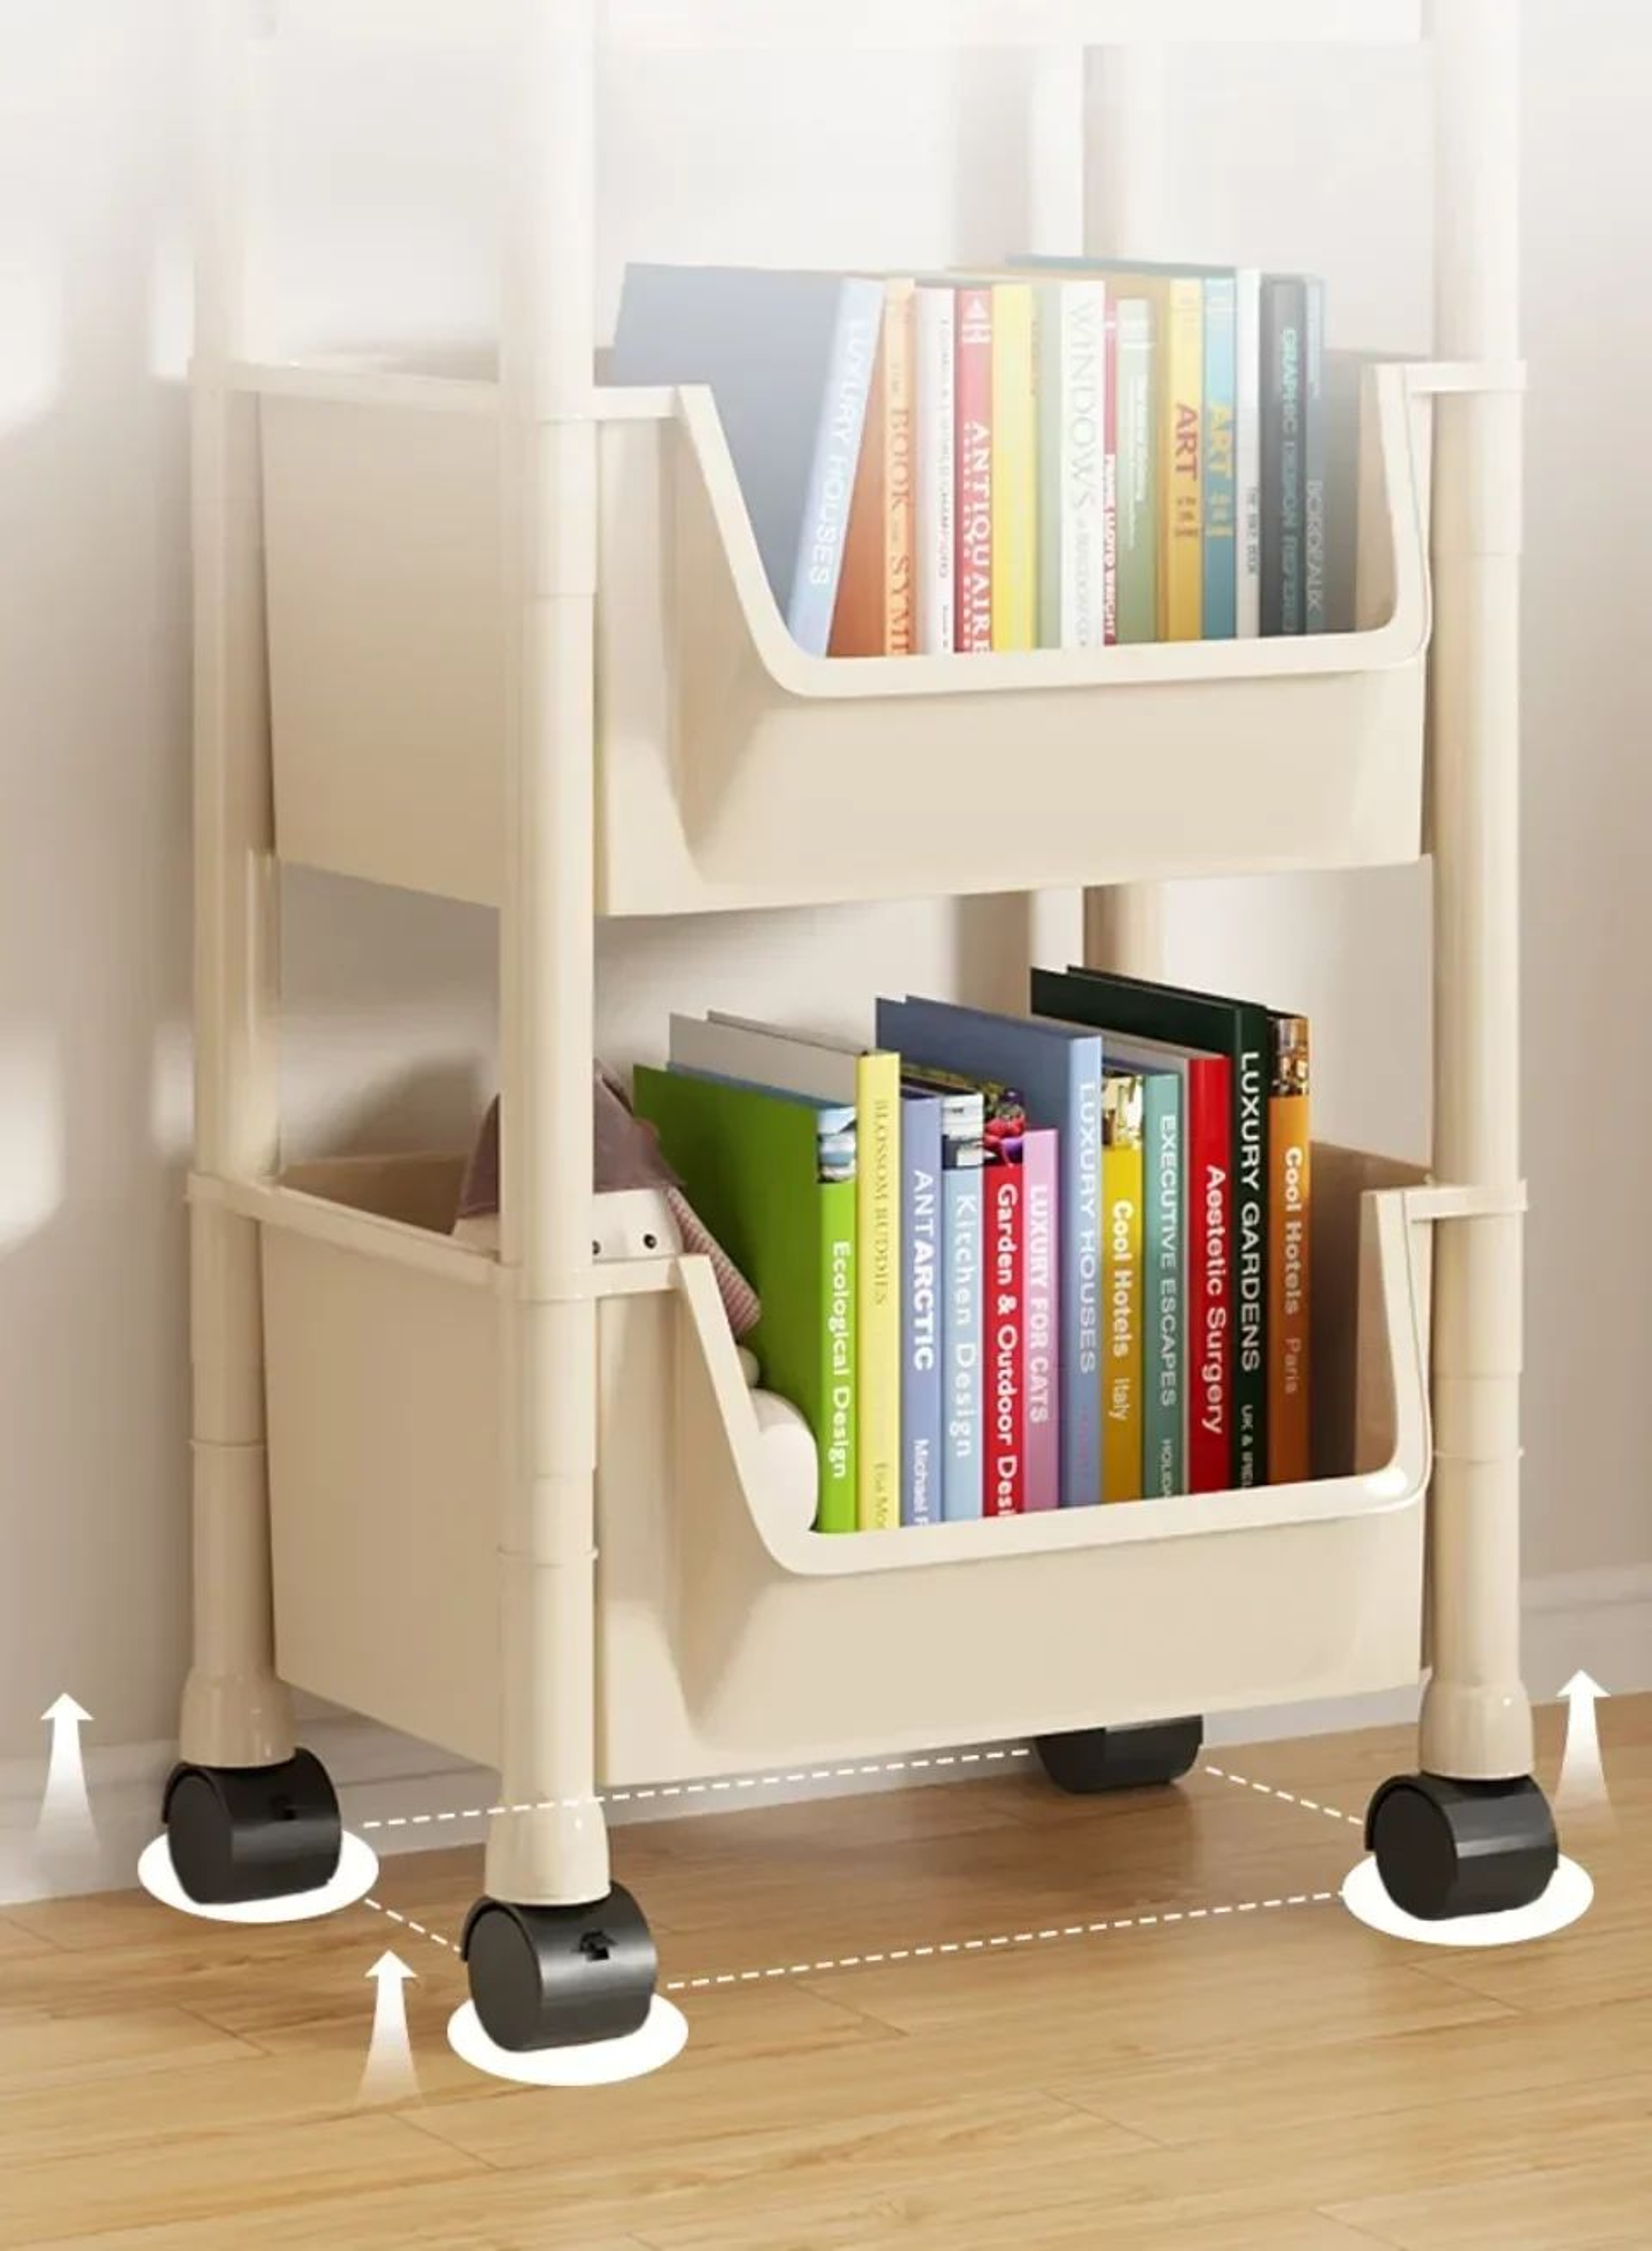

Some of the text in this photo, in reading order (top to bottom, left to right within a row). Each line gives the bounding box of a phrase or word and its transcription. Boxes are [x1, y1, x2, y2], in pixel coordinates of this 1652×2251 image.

[1071, 301, 1097, 510] WINDOWS
[1176, 403, 1199, 481] ART
[1210, 404, 1233, 480] ART
[1281, 328, 1298, 434] GRAPHIC
[809, 318, 869, 586] LUXURY HOUSES
[891, 408, 910, 511] BOOK
[1104, 513, 1116, 566] LLOYD
[1104, 569, 1116, 635] WRIGHT
[1307, 480, 1323, 613] BORDEAUX
[874, 1098, 890, 1200] BLOSSOM
[1242, 1051, 1261, 1190] LUXURY
[997, 1183, 1017, 1285] Garden
[1080, 1082, 1097, 1373] LUXURY HOUSES
[1161, 1114, 1177, 1268] EXECUTIVE
[914, 1169, 934, 1371] ANTARCTIC
[950, 1194, 977, 1458] Kitchen Design
[997, 1294, 1017, 1314] &
[1029, 1184, 1049, 1423] LUXURY FOR CATS
[1109, 1200, 1133, 1421] Cool Hotels Italy
[1203, 1164, 1226, 1434] Aestetic Surgery
[1242, 1201, 1261, 1372] GARDENS
[1284, 1145, 1302, 1394] Cool Hotels Paris
[828, 1241, 851, 1479] Ecological Design
[997, 1324, 1017, 1445] Outdoor
[1161, 1279, 1177, 1406] ESCAPES
[913, 1439, 929, 1512] Michael
